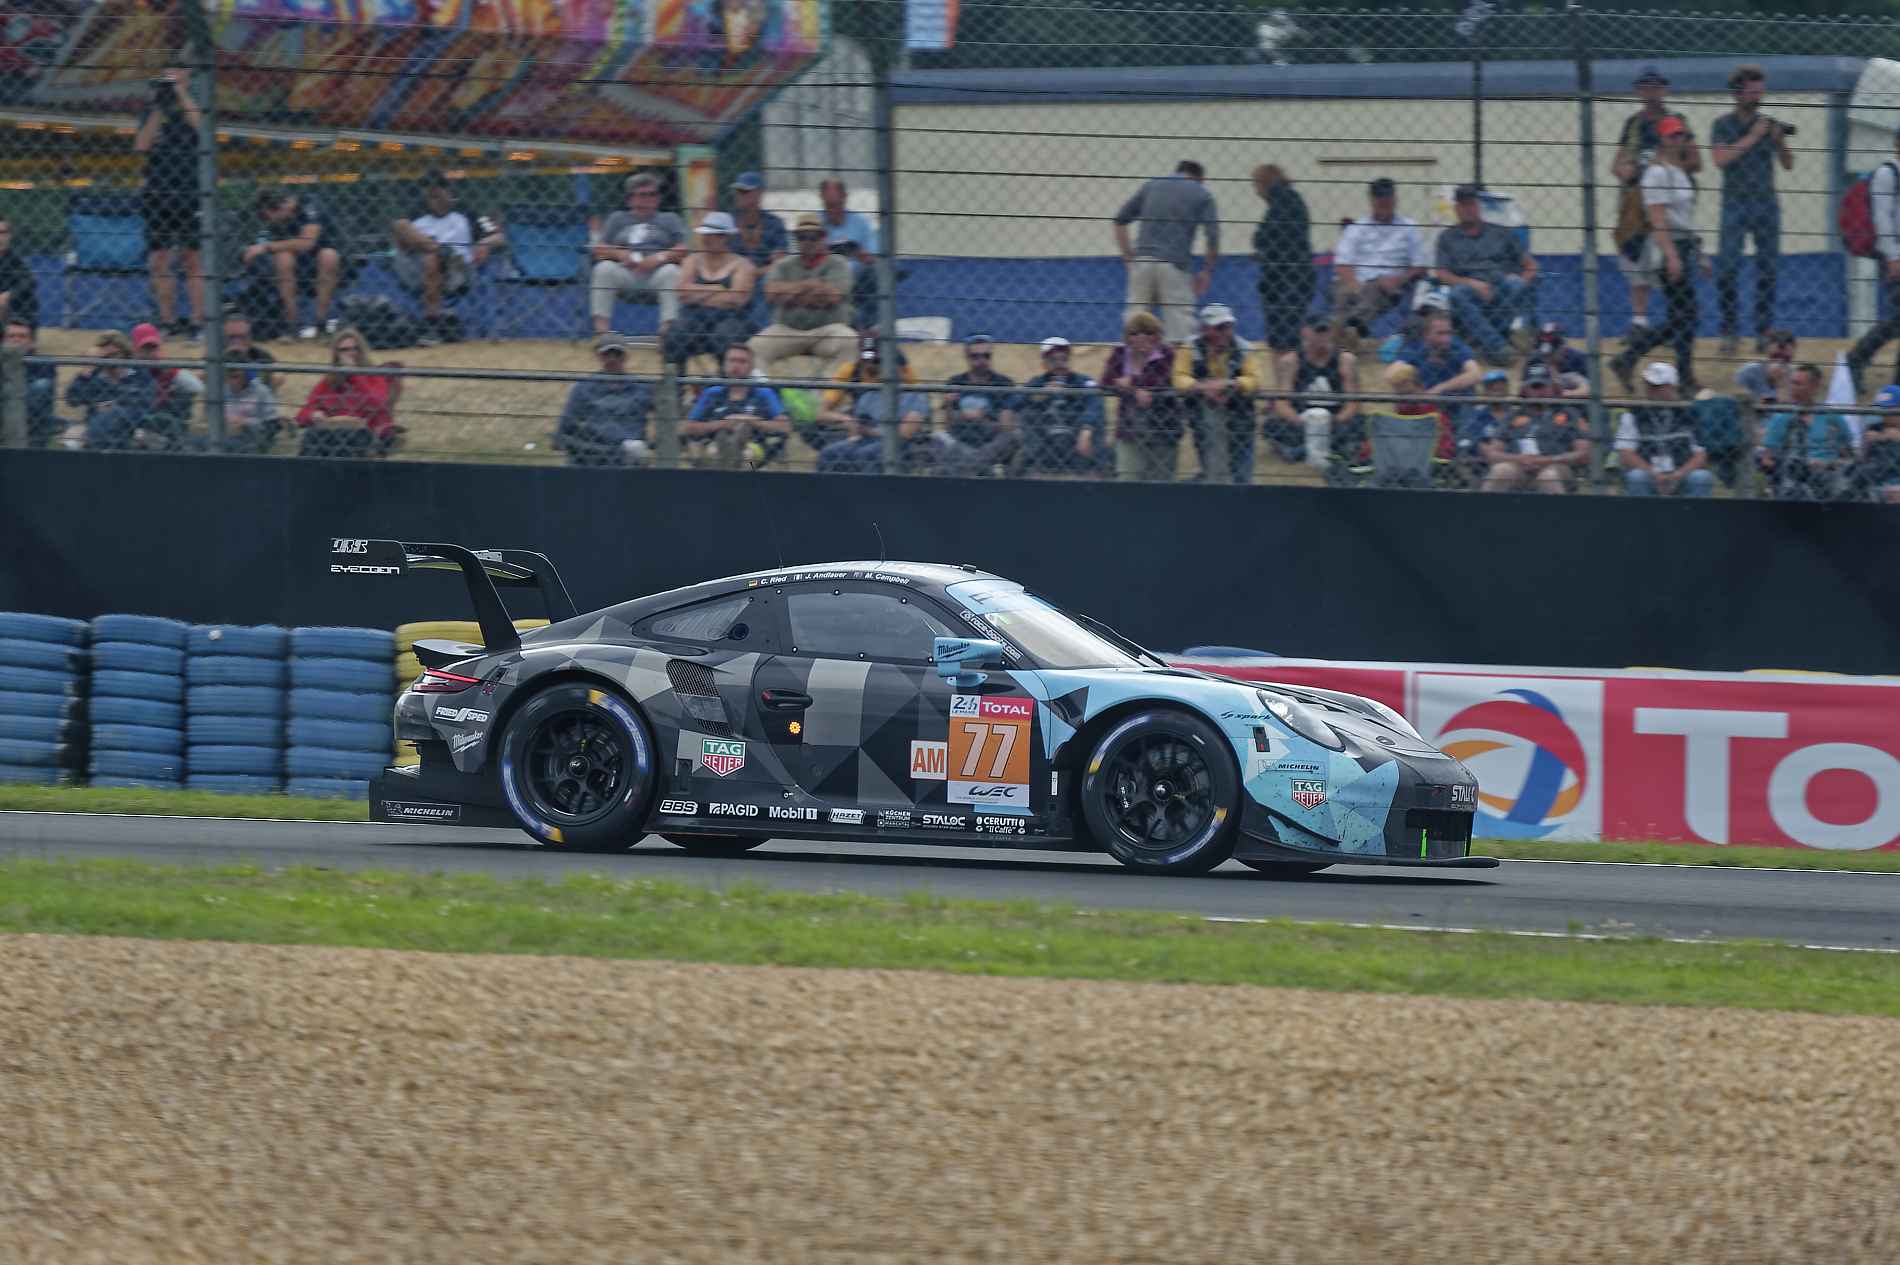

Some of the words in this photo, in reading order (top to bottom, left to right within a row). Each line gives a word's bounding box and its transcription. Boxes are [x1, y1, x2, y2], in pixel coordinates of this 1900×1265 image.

[760, 578, 768, 586] C.
[769, 575, 787, 584] Ried
[813, 571, 847, 579] Andlauer
[875, 573, 911, 585] Campbell
[982, 701, 1030, 715] TOTAL
[706, 741, 742, 755] TAG
[960, 722, 1019, 779] 77
[704, 755, 742, 773] HEUER
[912, 747, 945, 773] AM
[1278, 763, 1320, 771] MICHELIN
[968, 785, 1019, 798] WEC
[1294, 781, 1323, 792] TAG
[1294, 792, 1324, 808] HEUER
[403, 807, 454, 817] MICHELIN
[660, 800, 698, 815] BBS
[721, 803, 759, 817] PAGID
[769, 806, 804, 819] Mobil
[922, 814, 966, 826] STALOC
[983, 816, 1018, 827] CERUTTI
